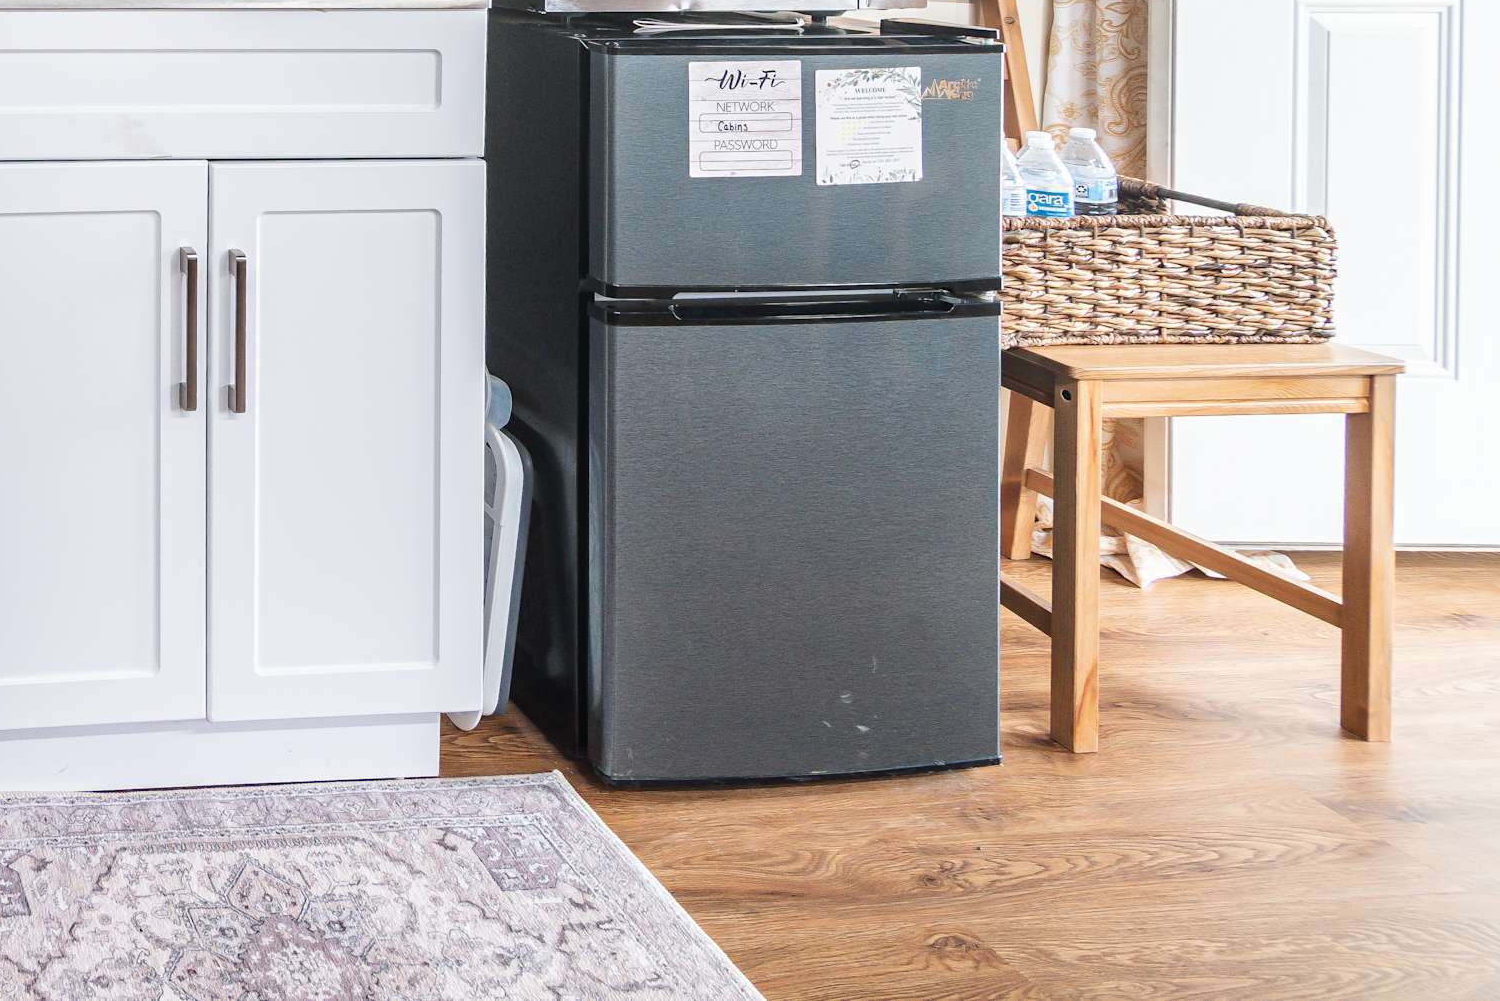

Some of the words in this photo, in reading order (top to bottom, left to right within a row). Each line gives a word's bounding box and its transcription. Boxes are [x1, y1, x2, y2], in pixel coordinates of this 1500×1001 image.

[704, 69, 786, 90] Wi-Fi
[716, 101, 776, 112] NETWORK
[717, 120, 748, 132] Cabins
[713, 139, 779, 150] PASSWORD
